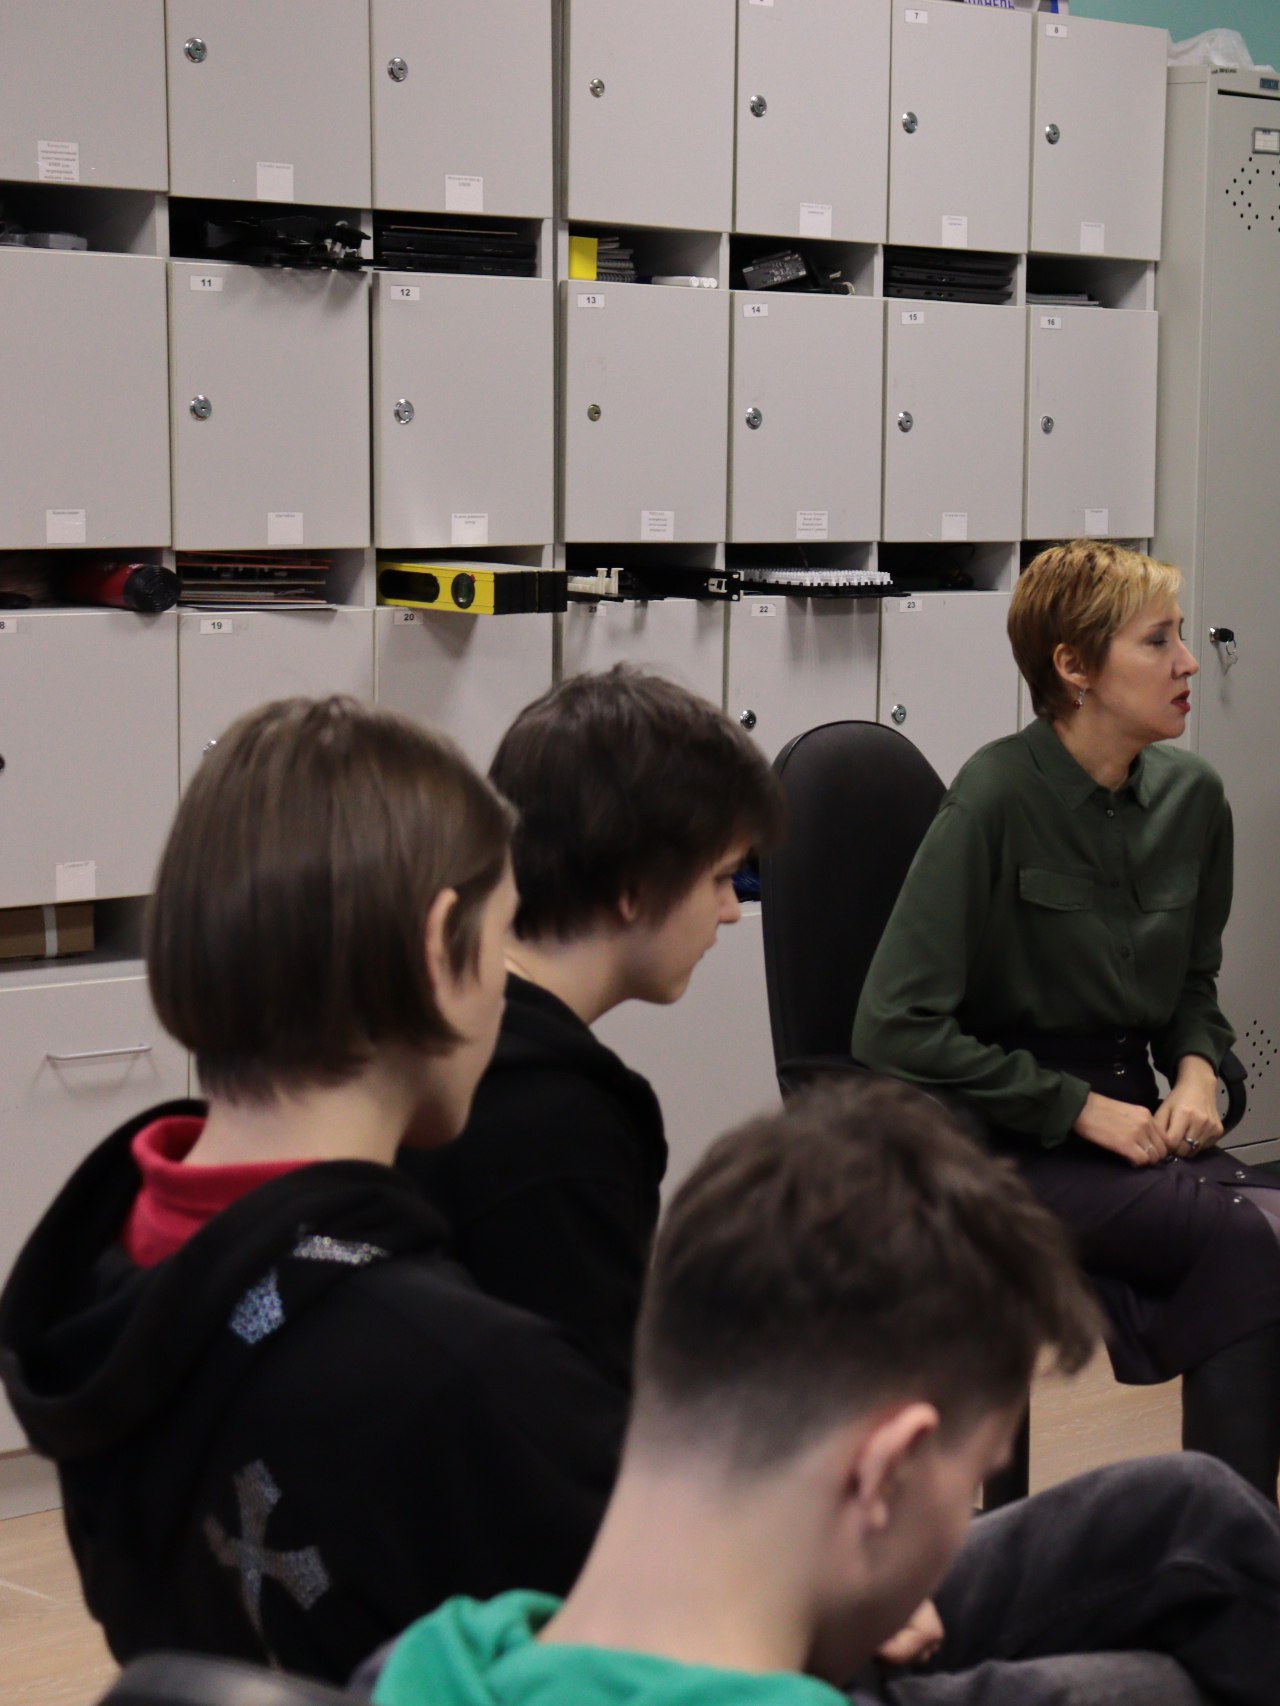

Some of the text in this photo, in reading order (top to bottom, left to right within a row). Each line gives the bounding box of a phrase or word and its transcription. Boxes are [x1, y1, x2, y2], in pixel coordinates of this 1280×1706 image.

[914, 12, 919, 20] 7
[201, 279, 212, 287] 11
[400, 288, 411, 297] 12
[586, 296, 597, 304] 13
[909, 313, 918, 321] 15
[1047, 318, 1056, 326] 16
[759, 605, 768, 613] 22
[907, 601, 916, 609] 23
[403, 613, 415, 621] 20
[211, 621, 223, 630] 19
